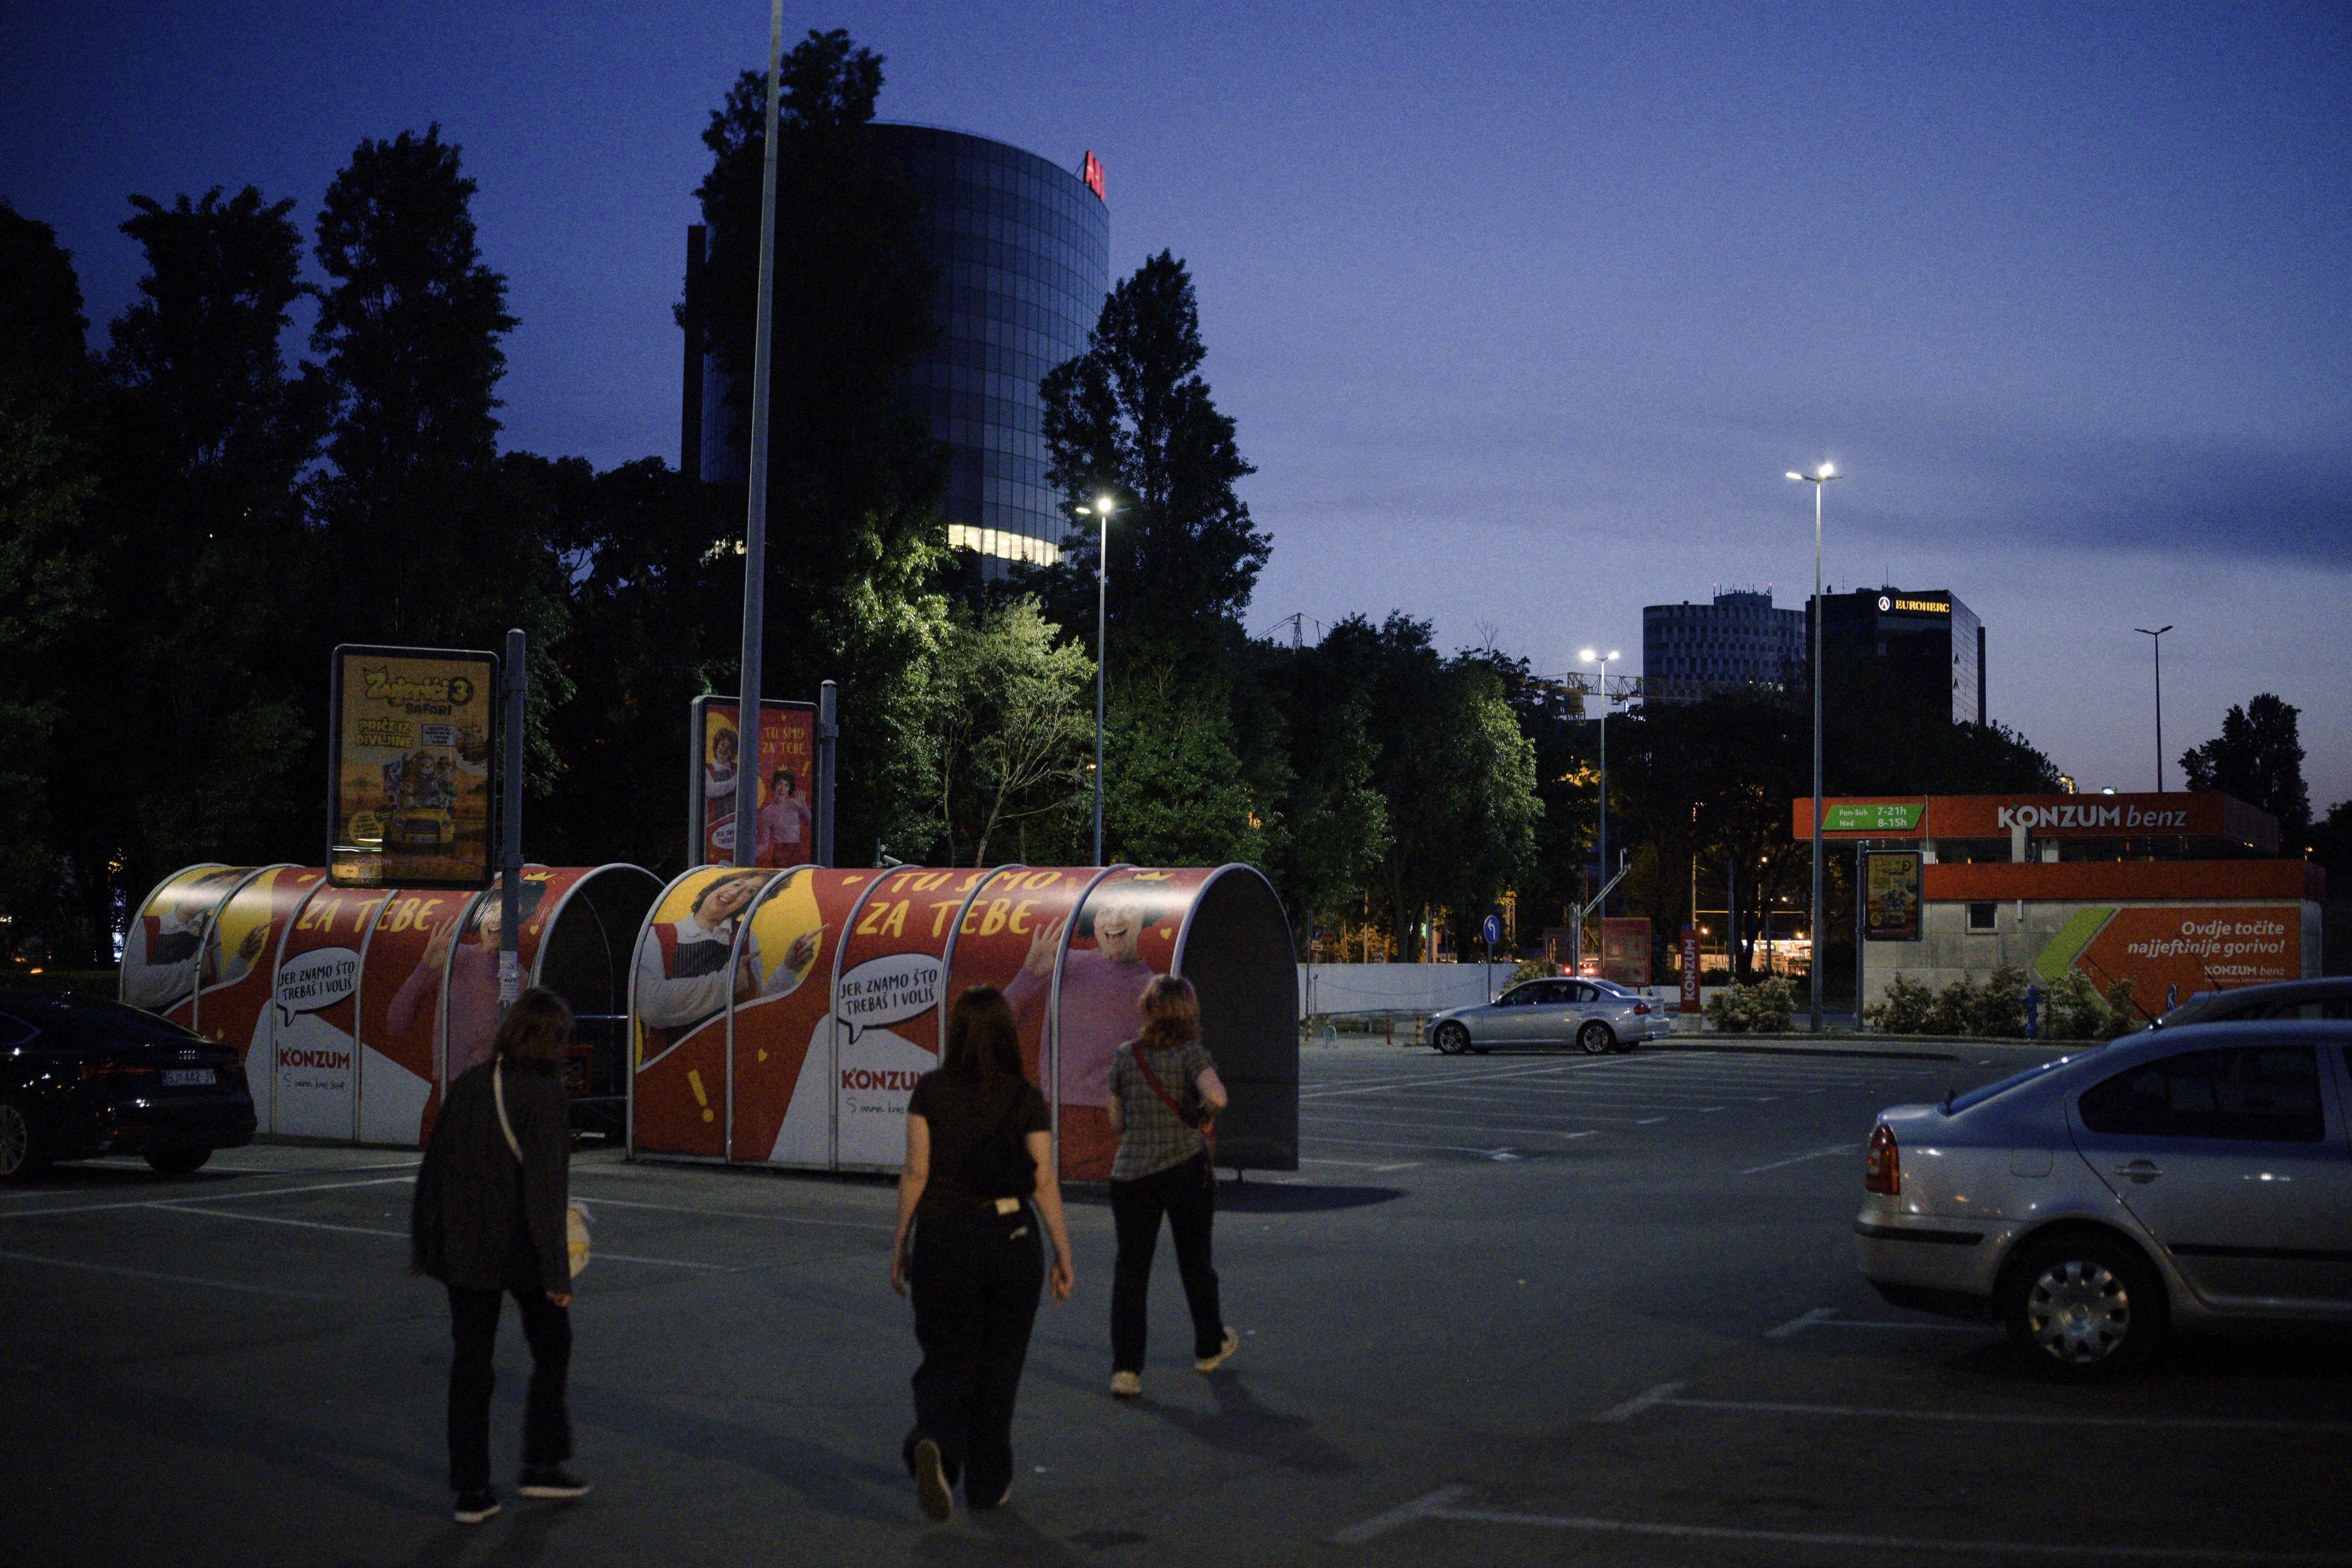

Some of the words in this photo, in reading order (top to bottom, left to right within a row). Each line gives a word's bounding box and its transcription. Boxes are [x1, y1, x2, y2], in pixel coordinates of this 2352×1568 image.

[1895, 600, 1949, 612] EUROHERC
[405, 703, 452, 715] SAFARI
[765, 727, 778, 738] TU
[784, 726, 804, 739] SMO
[761, 742, 775, 753] ZA
[780, 742, 805, 754] TEBE
[1877, 807, 1906, 815] 7-21h
[1998, 804, 2120, 828] KONZUM
[2126, 804, 2187, 828] benz
[1877, 818, 1907, 827] 8-15h
[891, 872, 954, 893] TU
[955, 871, 1063, 893] SMO
[296, 898, 342, 933] ZA
[353, 898, 443, 933] TEBE
[856, 899, 910, 938] ZA
[929, 898, 1041, 938] TEBE
[2181, 919, 2231, 939] Ovdje
[2235, 919, 2285, 935] točite
[2128, 939, 2221, 957] najjeftinije
[2223, 939, 2285, 957] gorivo!
[280, 972, 295, 986] JER
[299, 965, 332, 980] ZNAMO
[336, 960, 355, 976] ŠTO
[1684, 939, 1695, 1001] KONZUM
[2204, 965, 2256, 976] KONZUM
[2259, 966, 2285, 976] benz
[282, 981, 316, 1001] TREBAŠ
[326, 977, 352, 993] VOLIŠ
[841, 982, 862, 999] JER
[867, 974, 908, 993] ZNAMO
[914, 968, 937, 985] ŠTO
[844, 992, 888, 1015] TREBAŠ
[894, 992, 896, 1007] I
[902, 984, 934, 1005] VOLIŠ
[280, 1048, 350, 1070] KONZUM
[842, 1069, 922, 1090] KONZU
[846, 1096, 857, 1114] S
